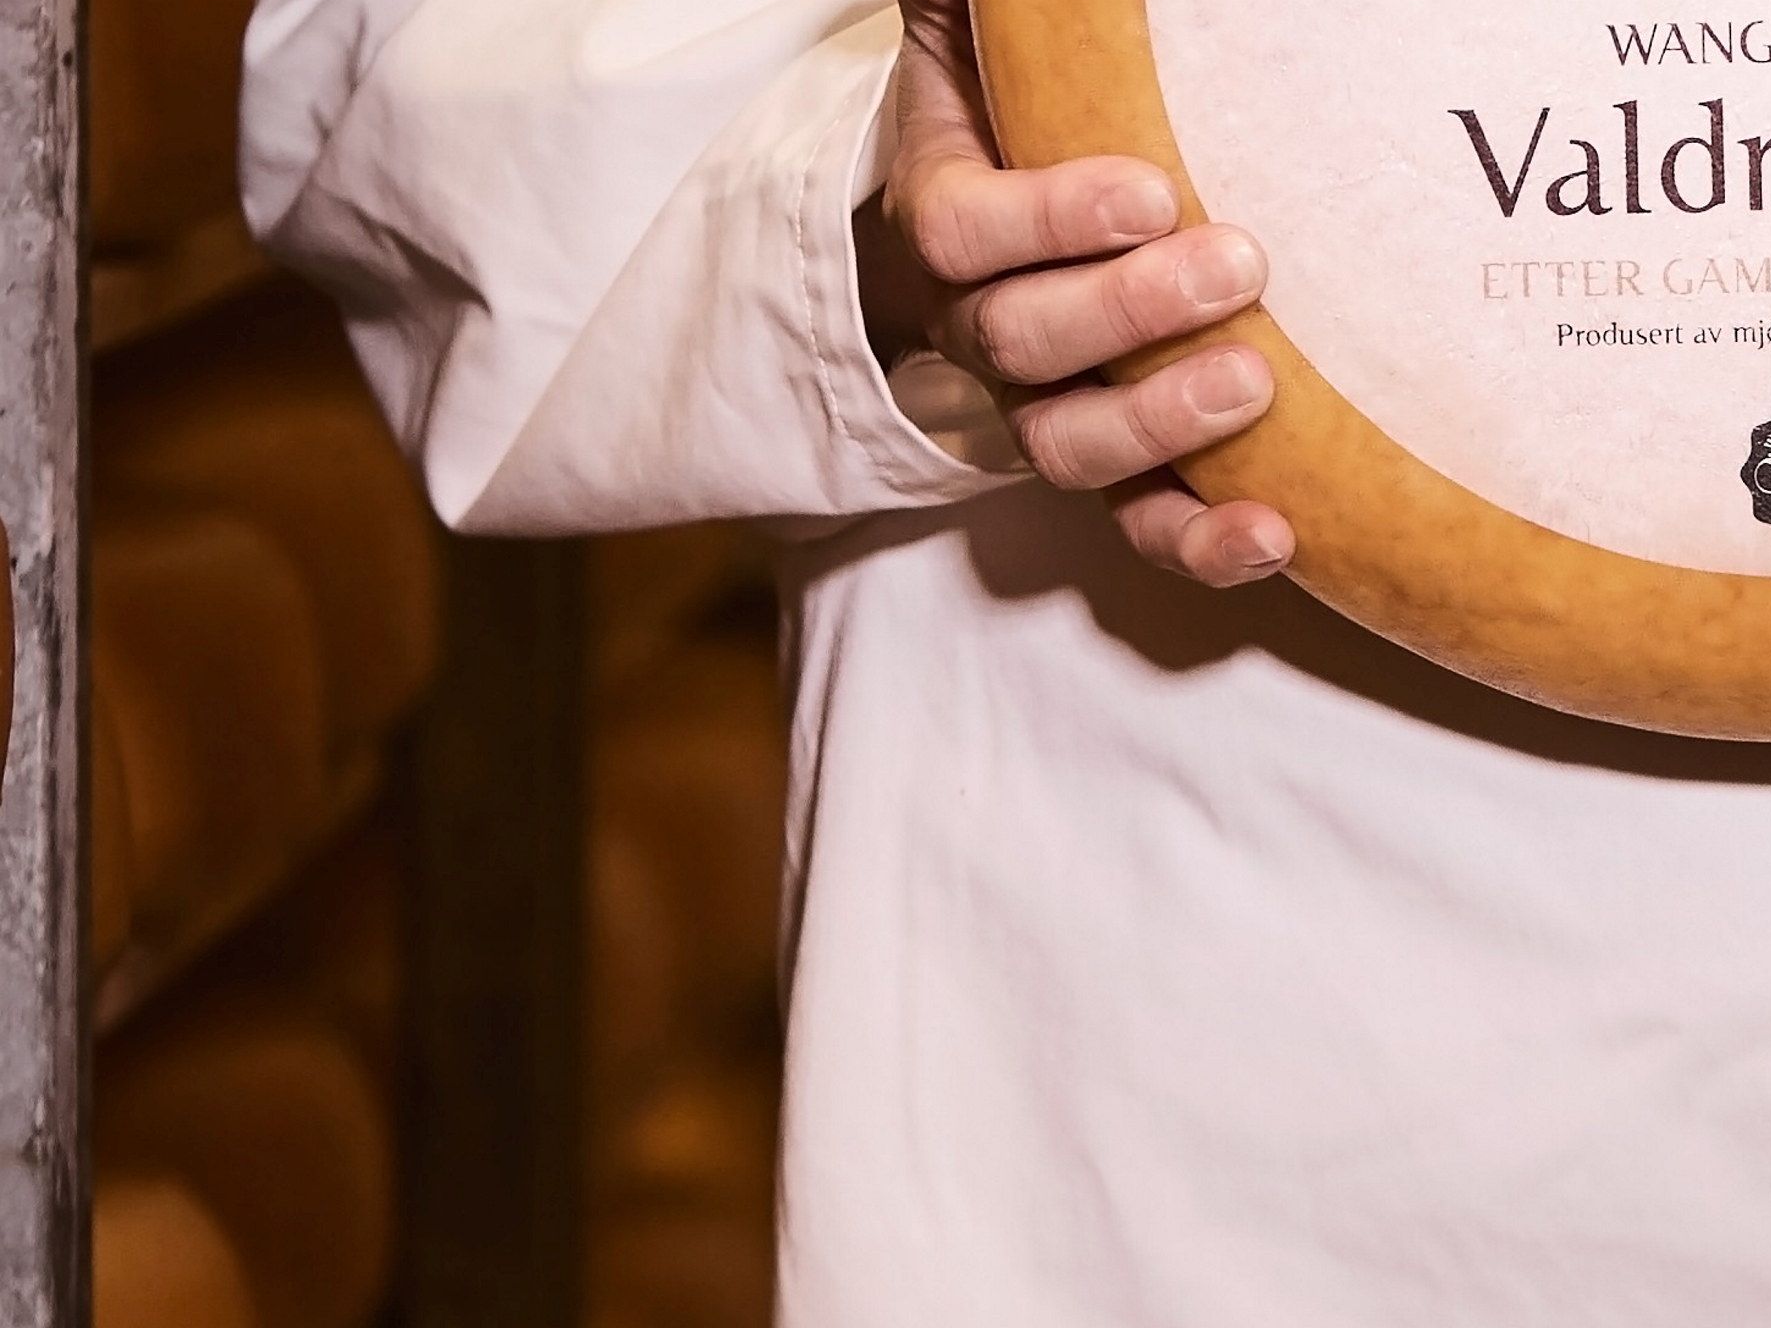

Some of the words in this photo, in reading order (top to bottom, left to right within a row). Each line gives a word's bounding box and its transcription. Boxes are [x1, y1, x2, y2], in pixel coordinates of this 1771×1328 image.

[1480, 259, 1644, 300] ETTER
[1557, 322, 1683, 346] Produsert
[1694, 327, 1722, 344] av
